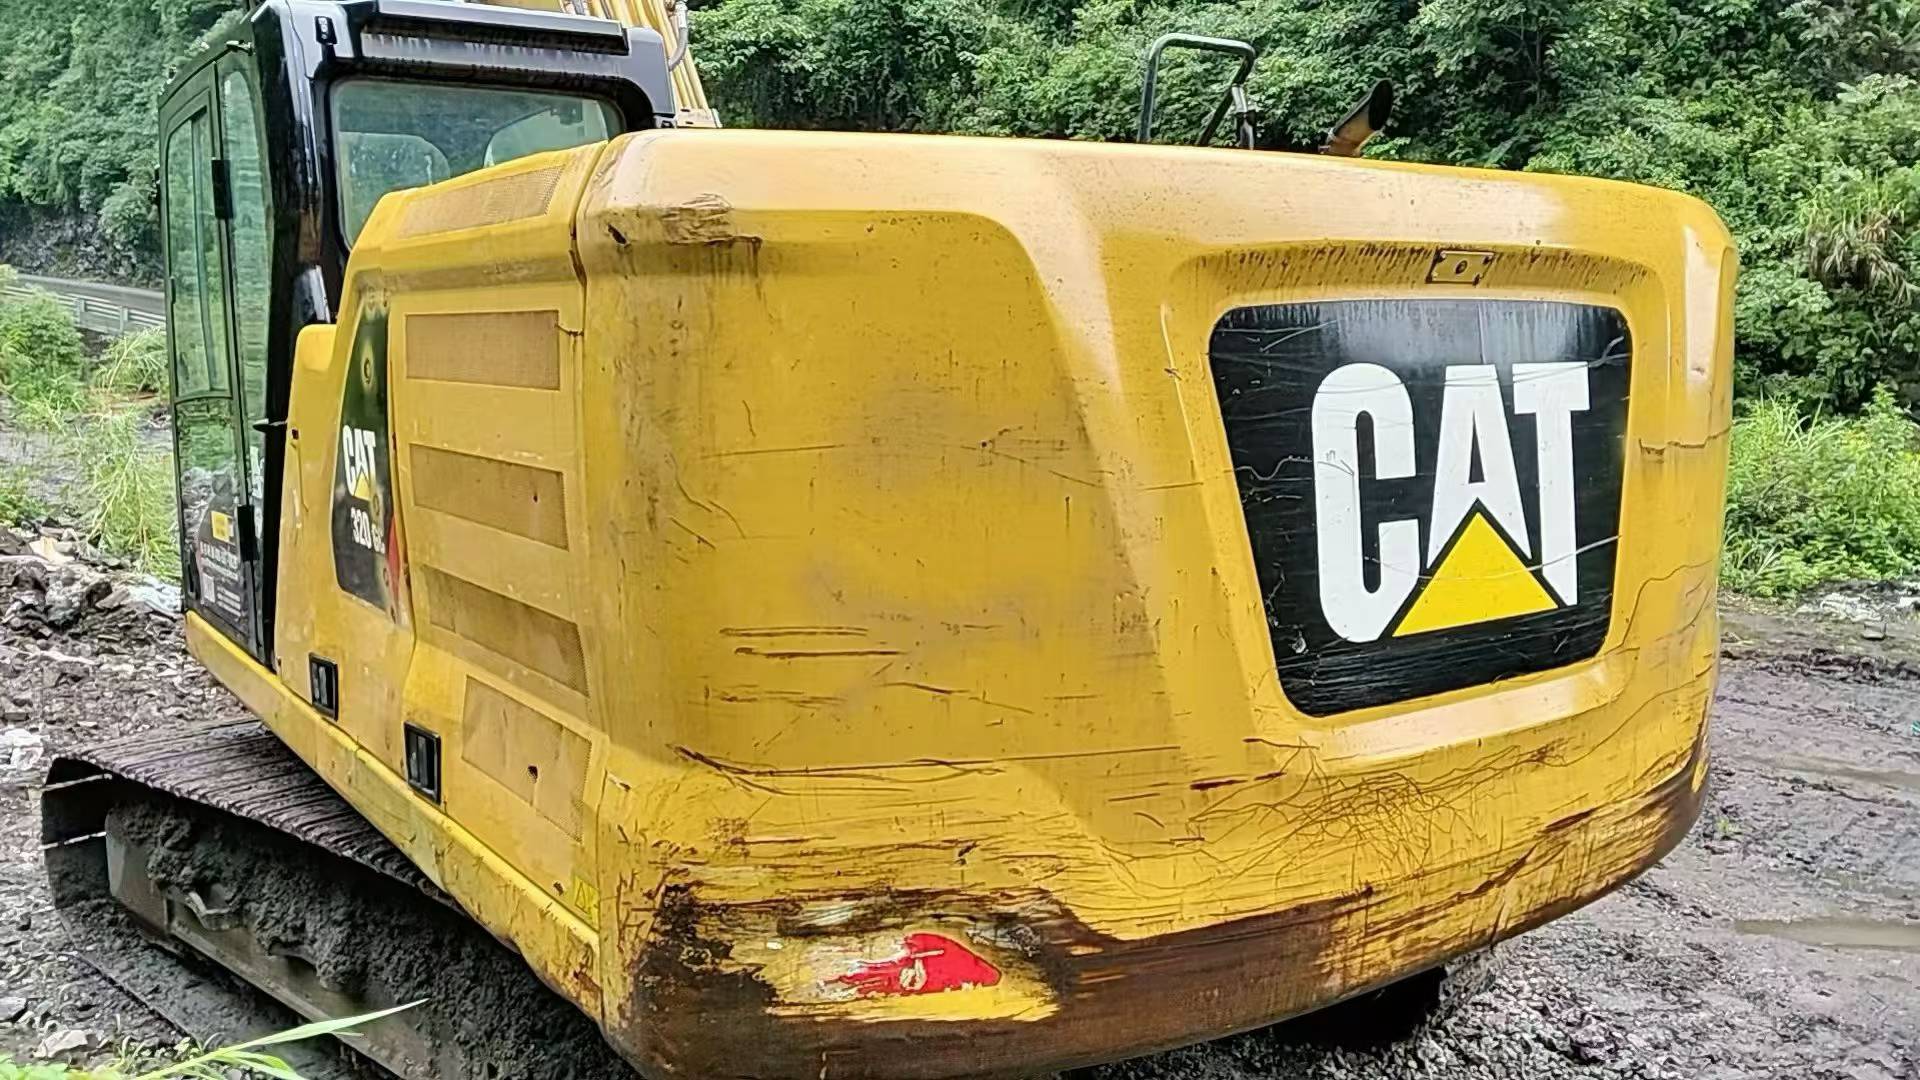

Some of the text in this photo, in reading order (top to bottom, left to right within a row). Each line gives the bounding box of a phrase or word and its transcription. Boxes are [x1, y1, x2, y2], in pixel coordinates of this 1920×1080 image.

[343, 425, 376, 496] CAT
[350, 507, 373, 549] 320
[1312, 362, 1590, 643] CAT
